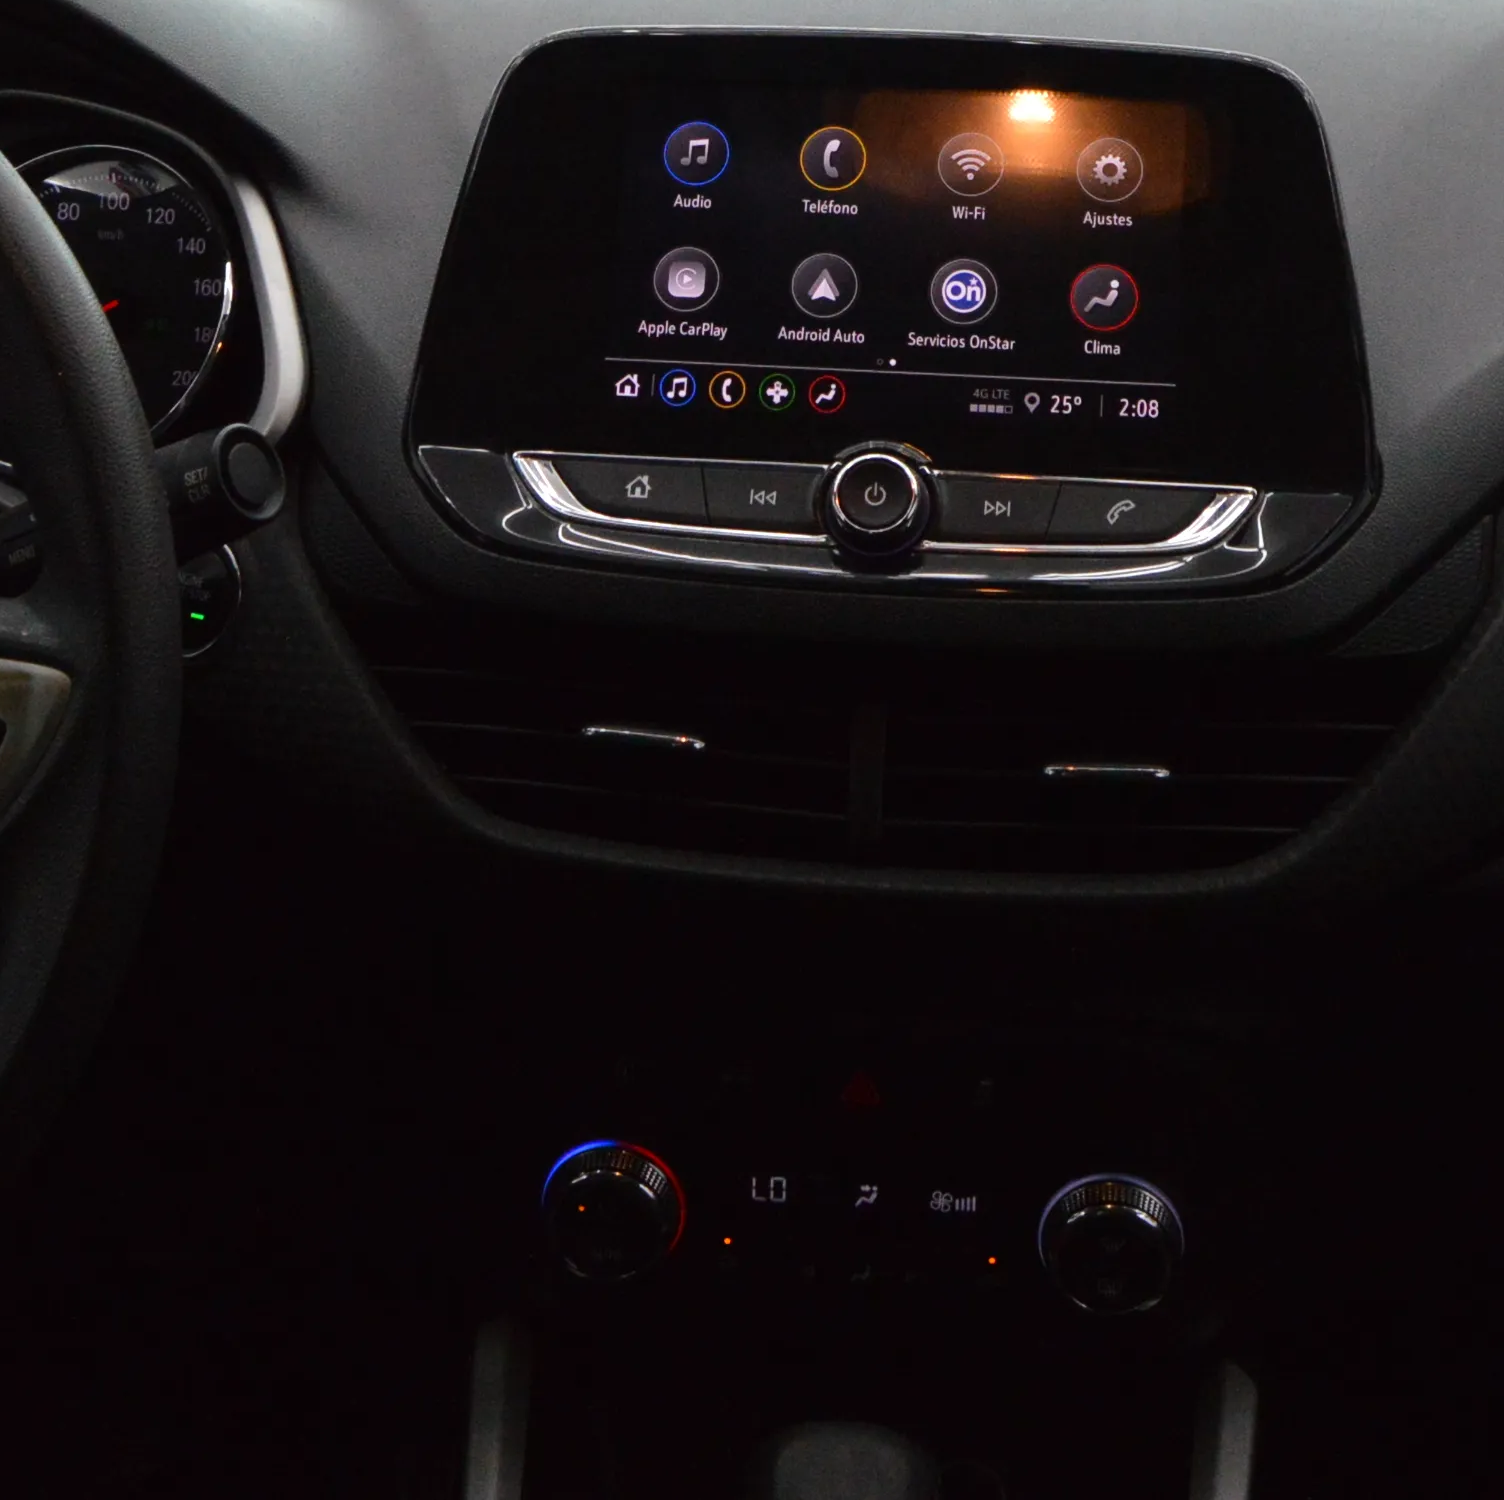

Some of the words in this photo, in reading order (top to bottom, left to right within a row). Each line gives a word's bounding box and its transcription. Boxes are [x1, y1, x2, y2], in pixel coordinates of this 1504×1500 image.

[99, 191, 131, 211] 100
[673, 193, 712, 209] Audio
[802, 198, 859, 216] Teléfono
[56, 202, 81, 222] 80
[145, 207, 177, 226] 120
[952, 204, 986, 221] Wi-Fi
[1082, 210, 1134, 229] Ajustes
[177, 237, 206, 256] 140
[193, 278, 222, 297] 160
[637, 319, 676, 339] Apple
[678, 321, 728, 340] CarPlay
[777, 325, 831, 343] Android
[833, 328, 866, 344] Auto
[907, 332, 966, 350] Servicios
[968, 335, 1017, 353] OnStar
[1083, 339, 1121, 356] Clima
[972, 388, 989, 400] 4G
[992, 388, 1010, 400] LTE
[1119, 398, 1159, 419] 2:08
